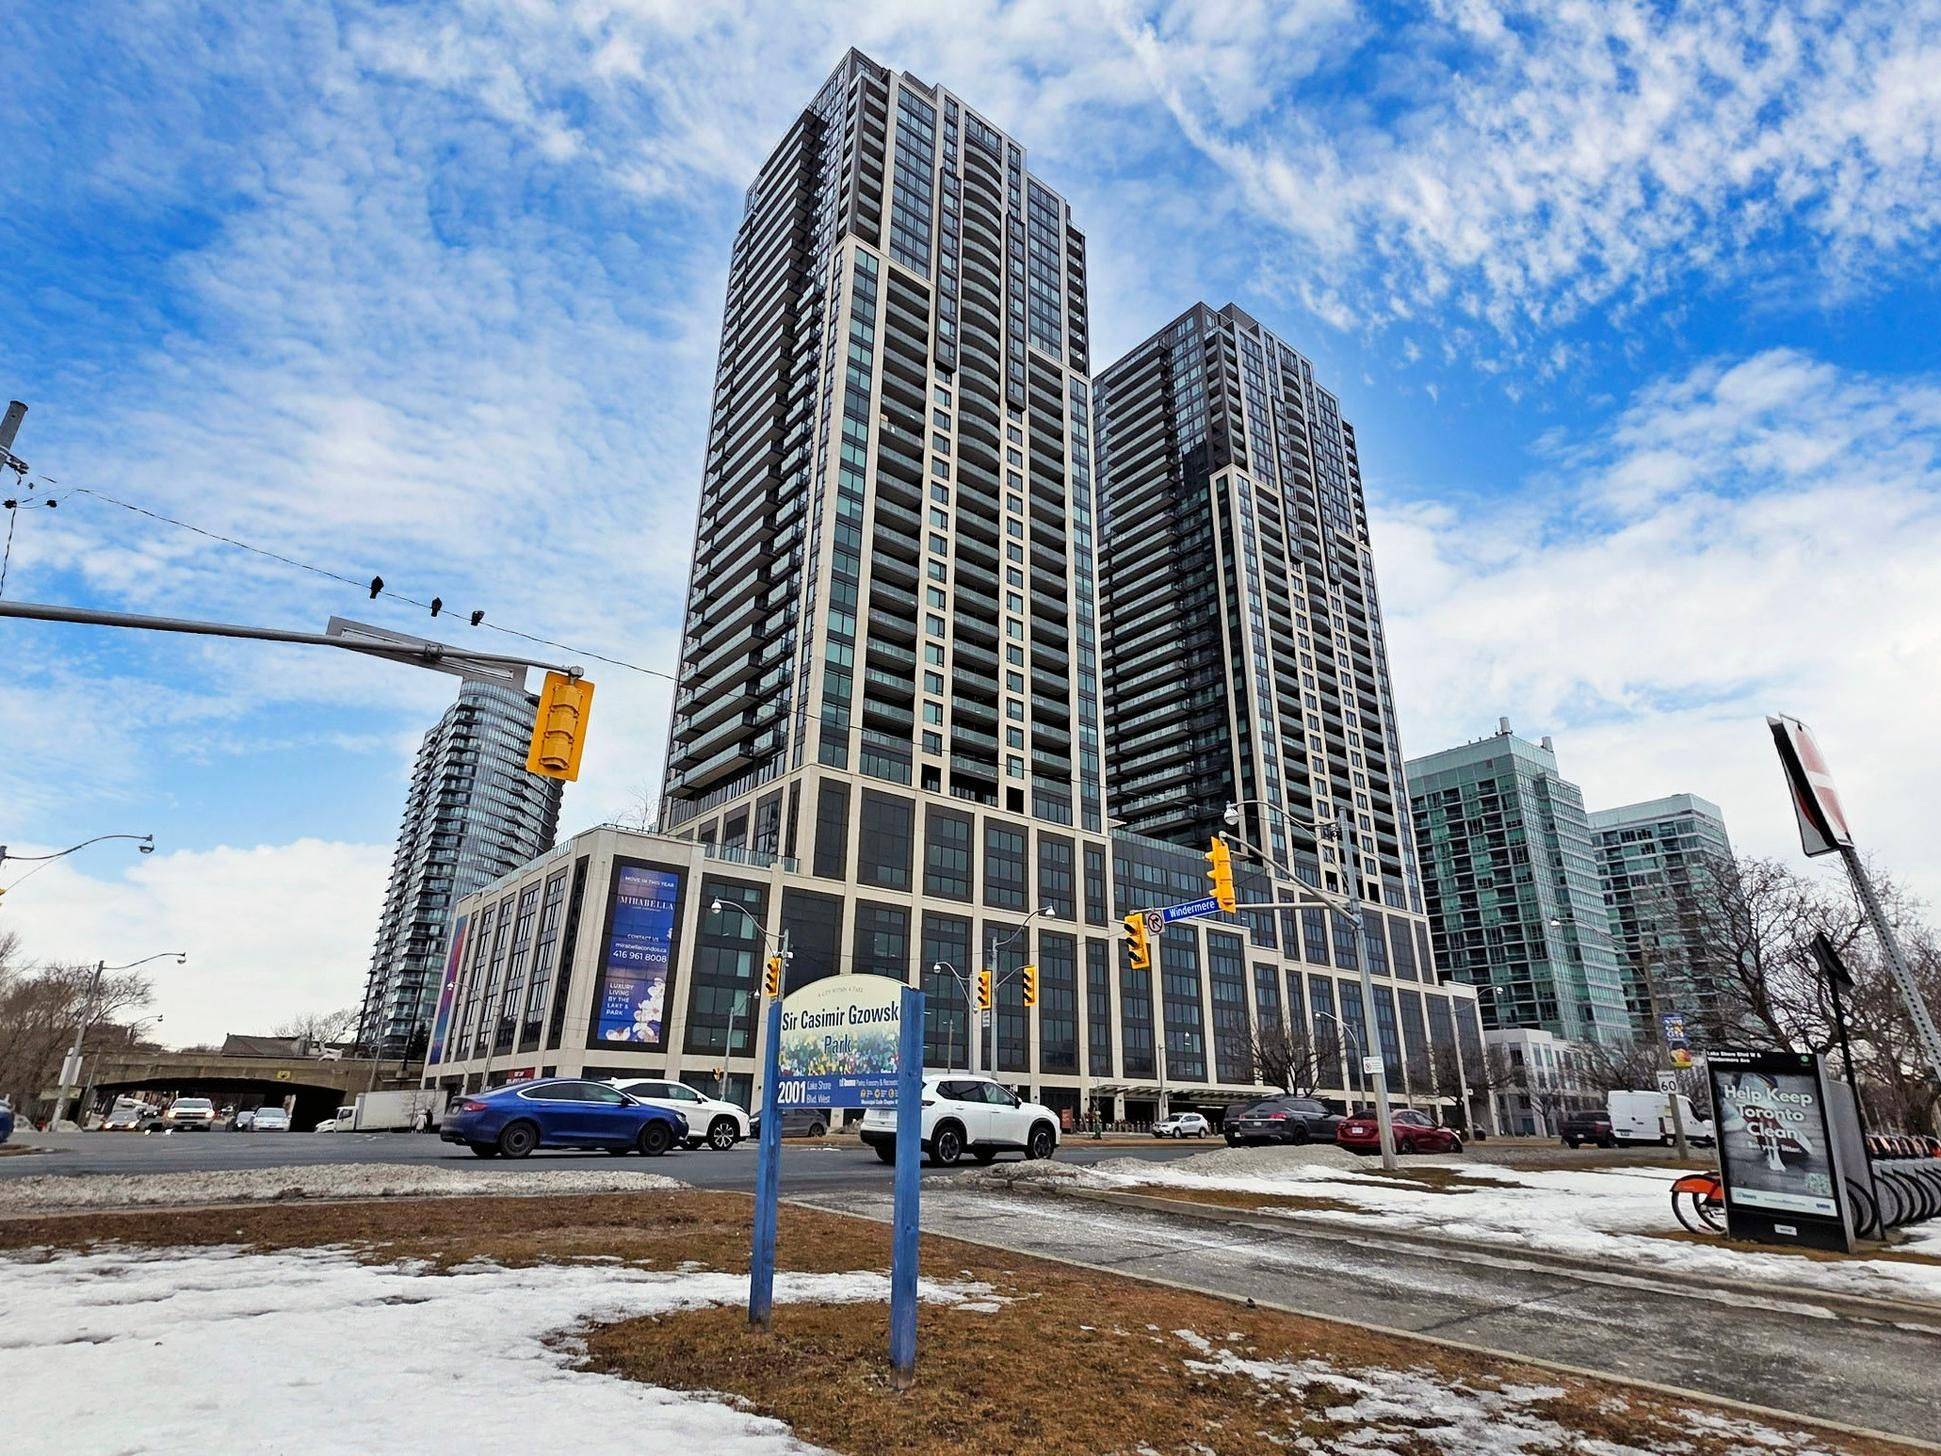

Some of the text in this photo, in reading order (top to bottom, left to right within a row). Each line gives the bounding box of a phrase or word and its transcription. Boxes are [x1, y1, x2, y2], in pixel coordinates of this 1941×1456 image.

[660, 880, 675, 888] YEAR
[620, 896, 674, 910] MIRABELLA
[1169, 900, 1215, 918] Windermere
[626, 933, 652, 941] CONTACT
[615, 942, 667, 953] mirabellacondos.ca
[612, 950, 667, 963] 416 961 8008
[610, 982, 634, 990] LUXURY
[782, 1000, 899, 1031] Sir Casimir Gzowsk
[824, 1034, 852, 1054] Park
[806, 1081, 818, 1090] Lake
[818, 1080, 832, 1090] Shore
[1661, 1080, 1677, 1092] 60
[777, 1080, 807, 1104] 2001
[1724, 1084, 1813, 1108] Help Keep
[817, 1094, 831, 1104] West
[1735, 1102, 1805, 1122] Toronto
[1746, 1121, 1798, 1139] Clean
